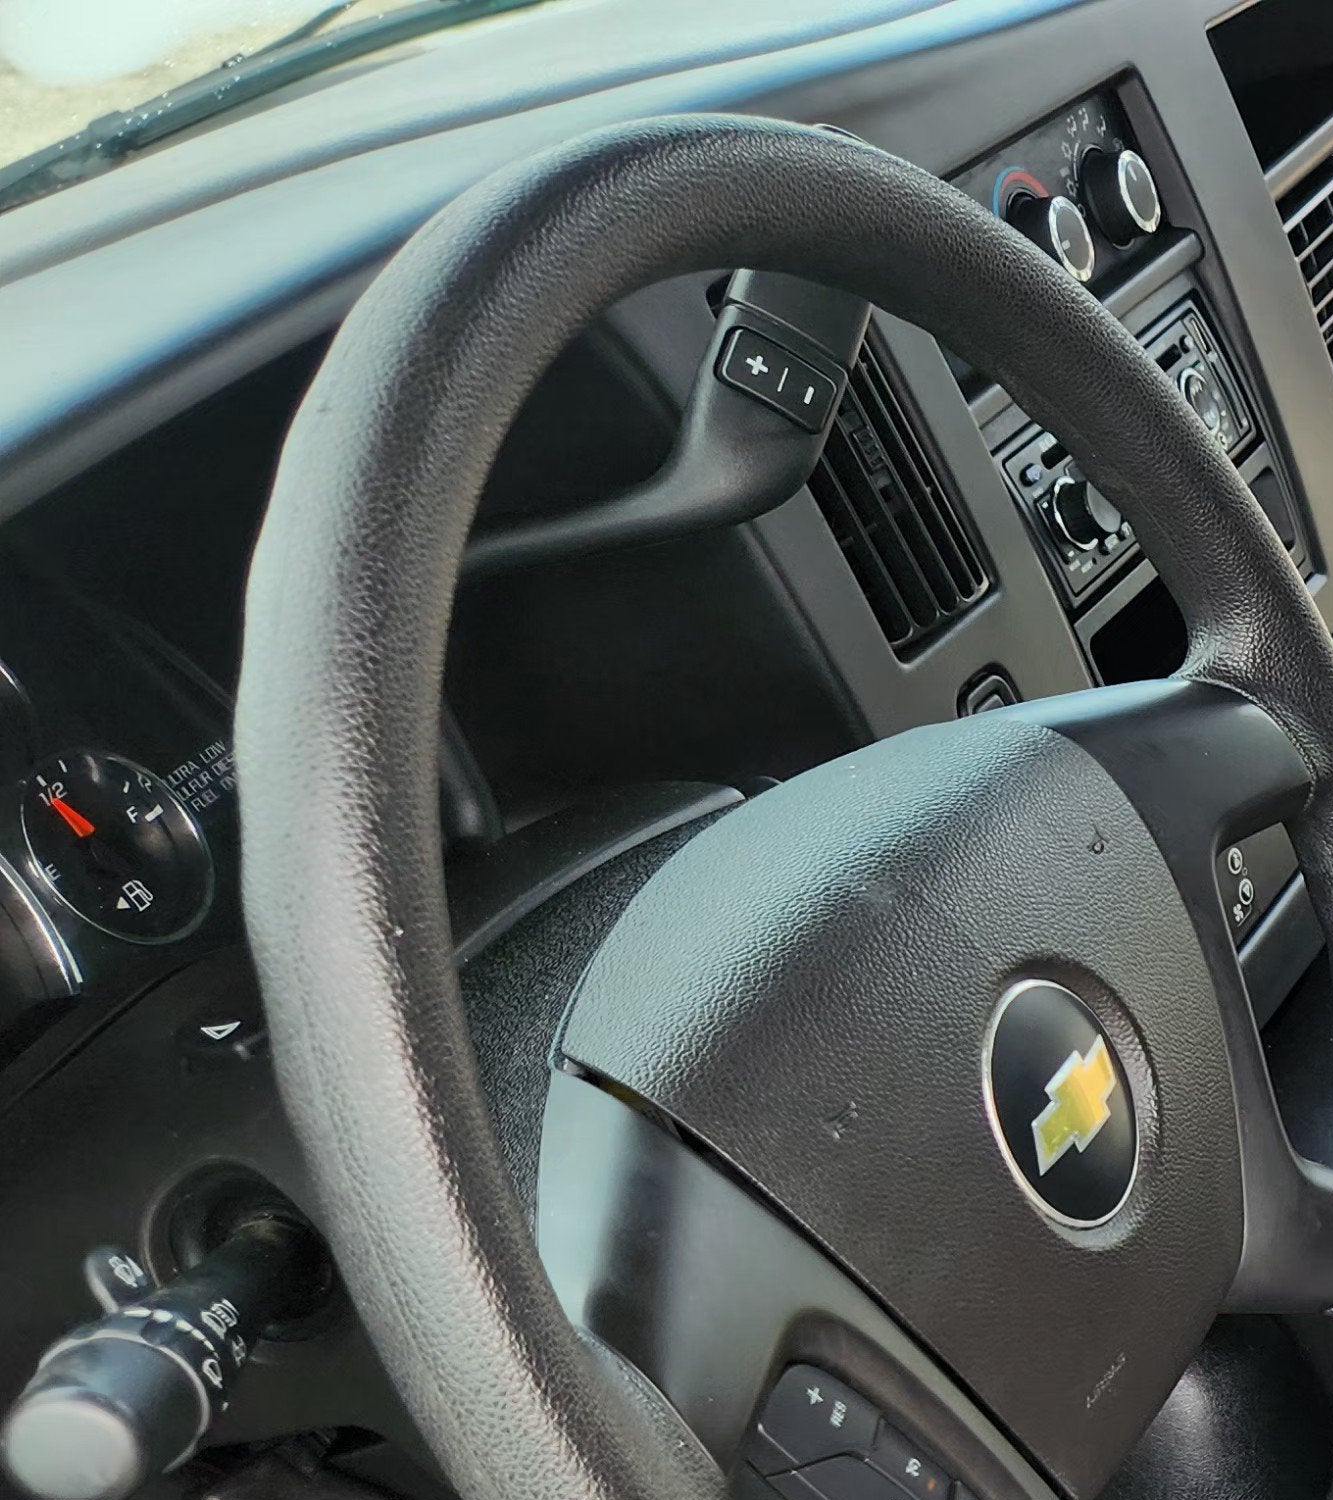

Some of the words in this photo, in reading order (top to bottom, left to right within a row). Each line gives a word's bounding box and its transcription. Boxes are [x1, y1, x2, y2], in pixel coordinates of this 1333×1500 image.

[199, 740, 226, 763] LOW
[126, 805, 139, 824] F
[44, 863, 61, 882] E
